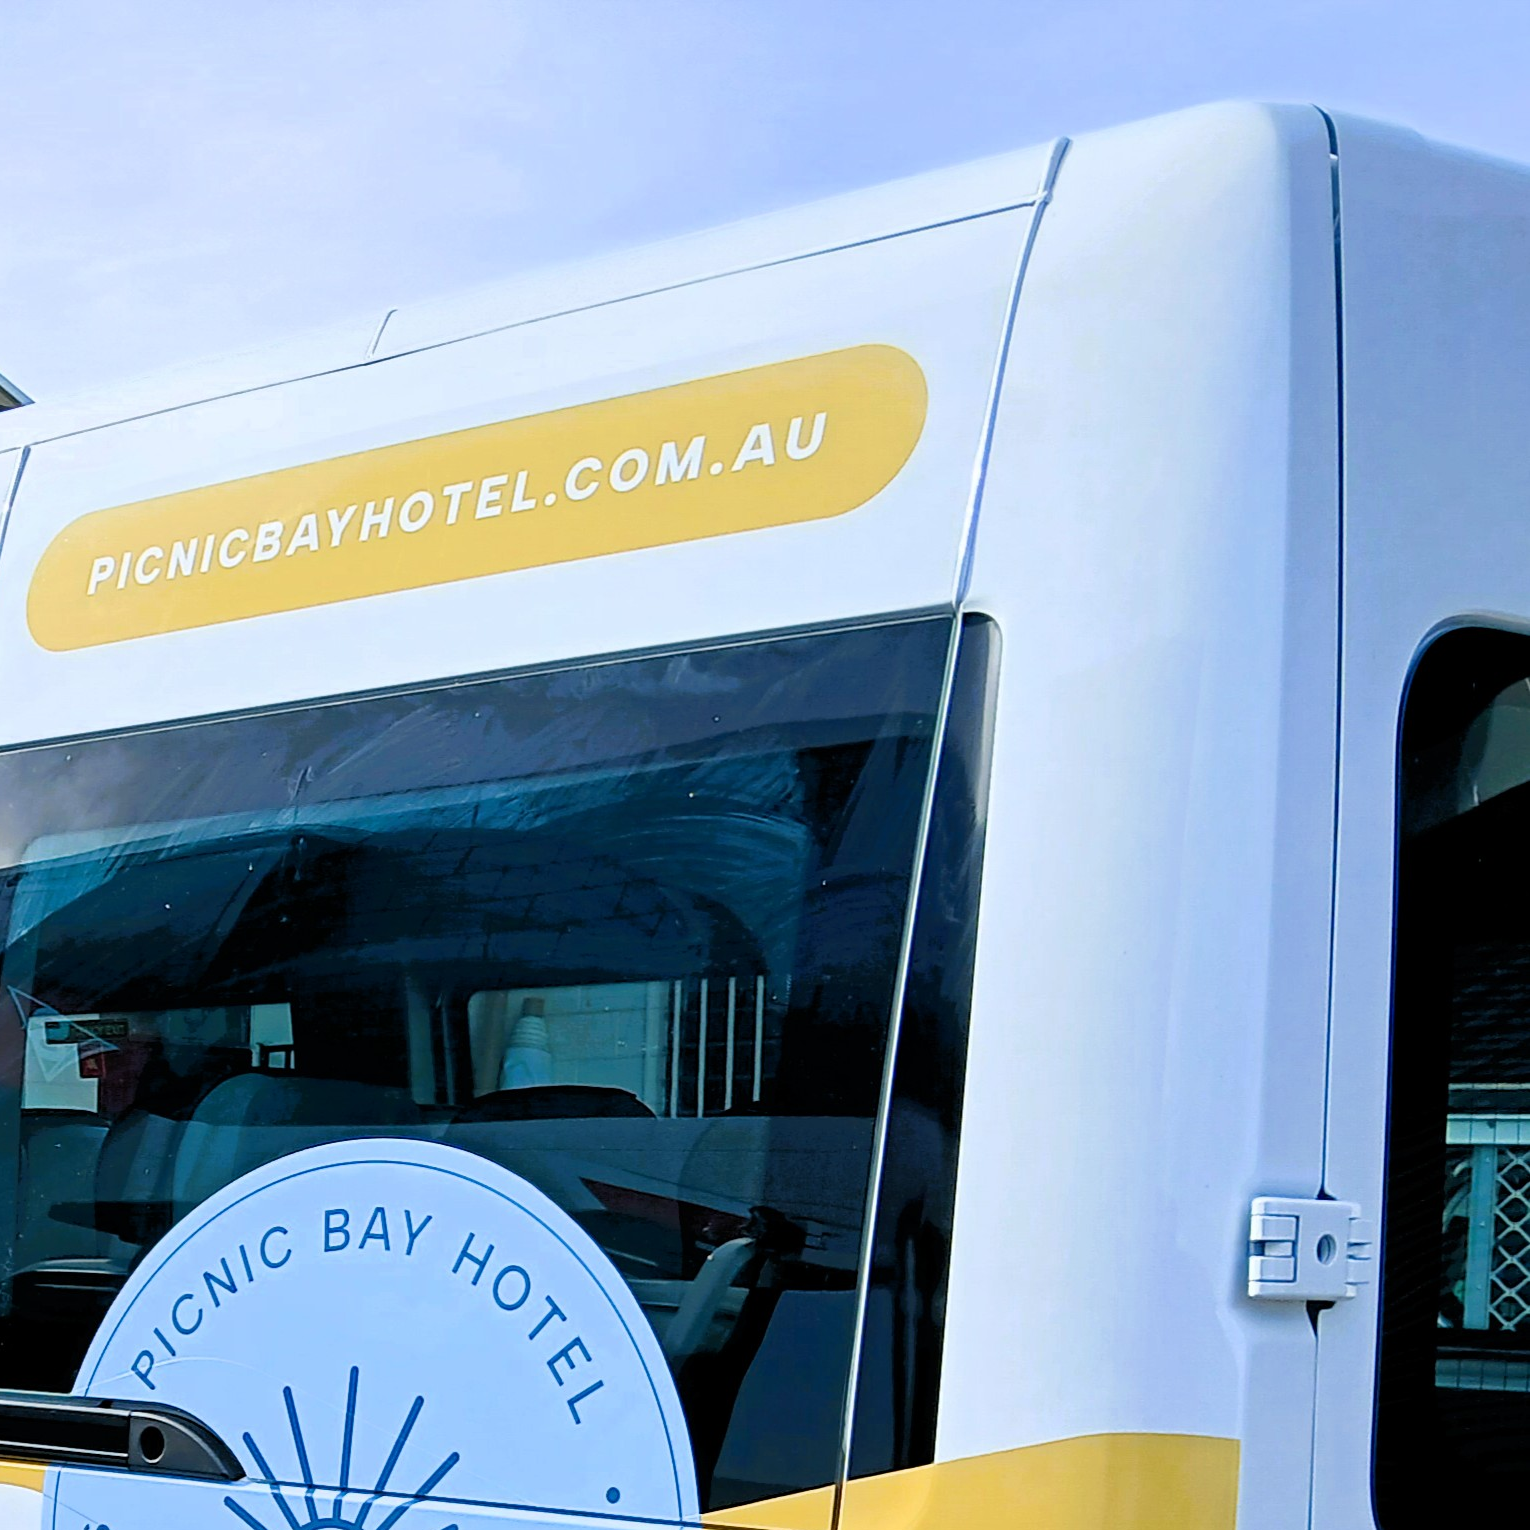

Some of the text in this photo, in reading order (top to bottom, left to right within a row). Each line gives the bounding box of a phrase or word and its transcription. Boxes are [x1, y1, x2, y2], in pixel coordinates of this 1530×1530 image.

[85, 410, 828, 597] PICNICBAYHOTEL.COM.AU
[130, 1205, 606, 1427] PICNIC BAY HOTEL
